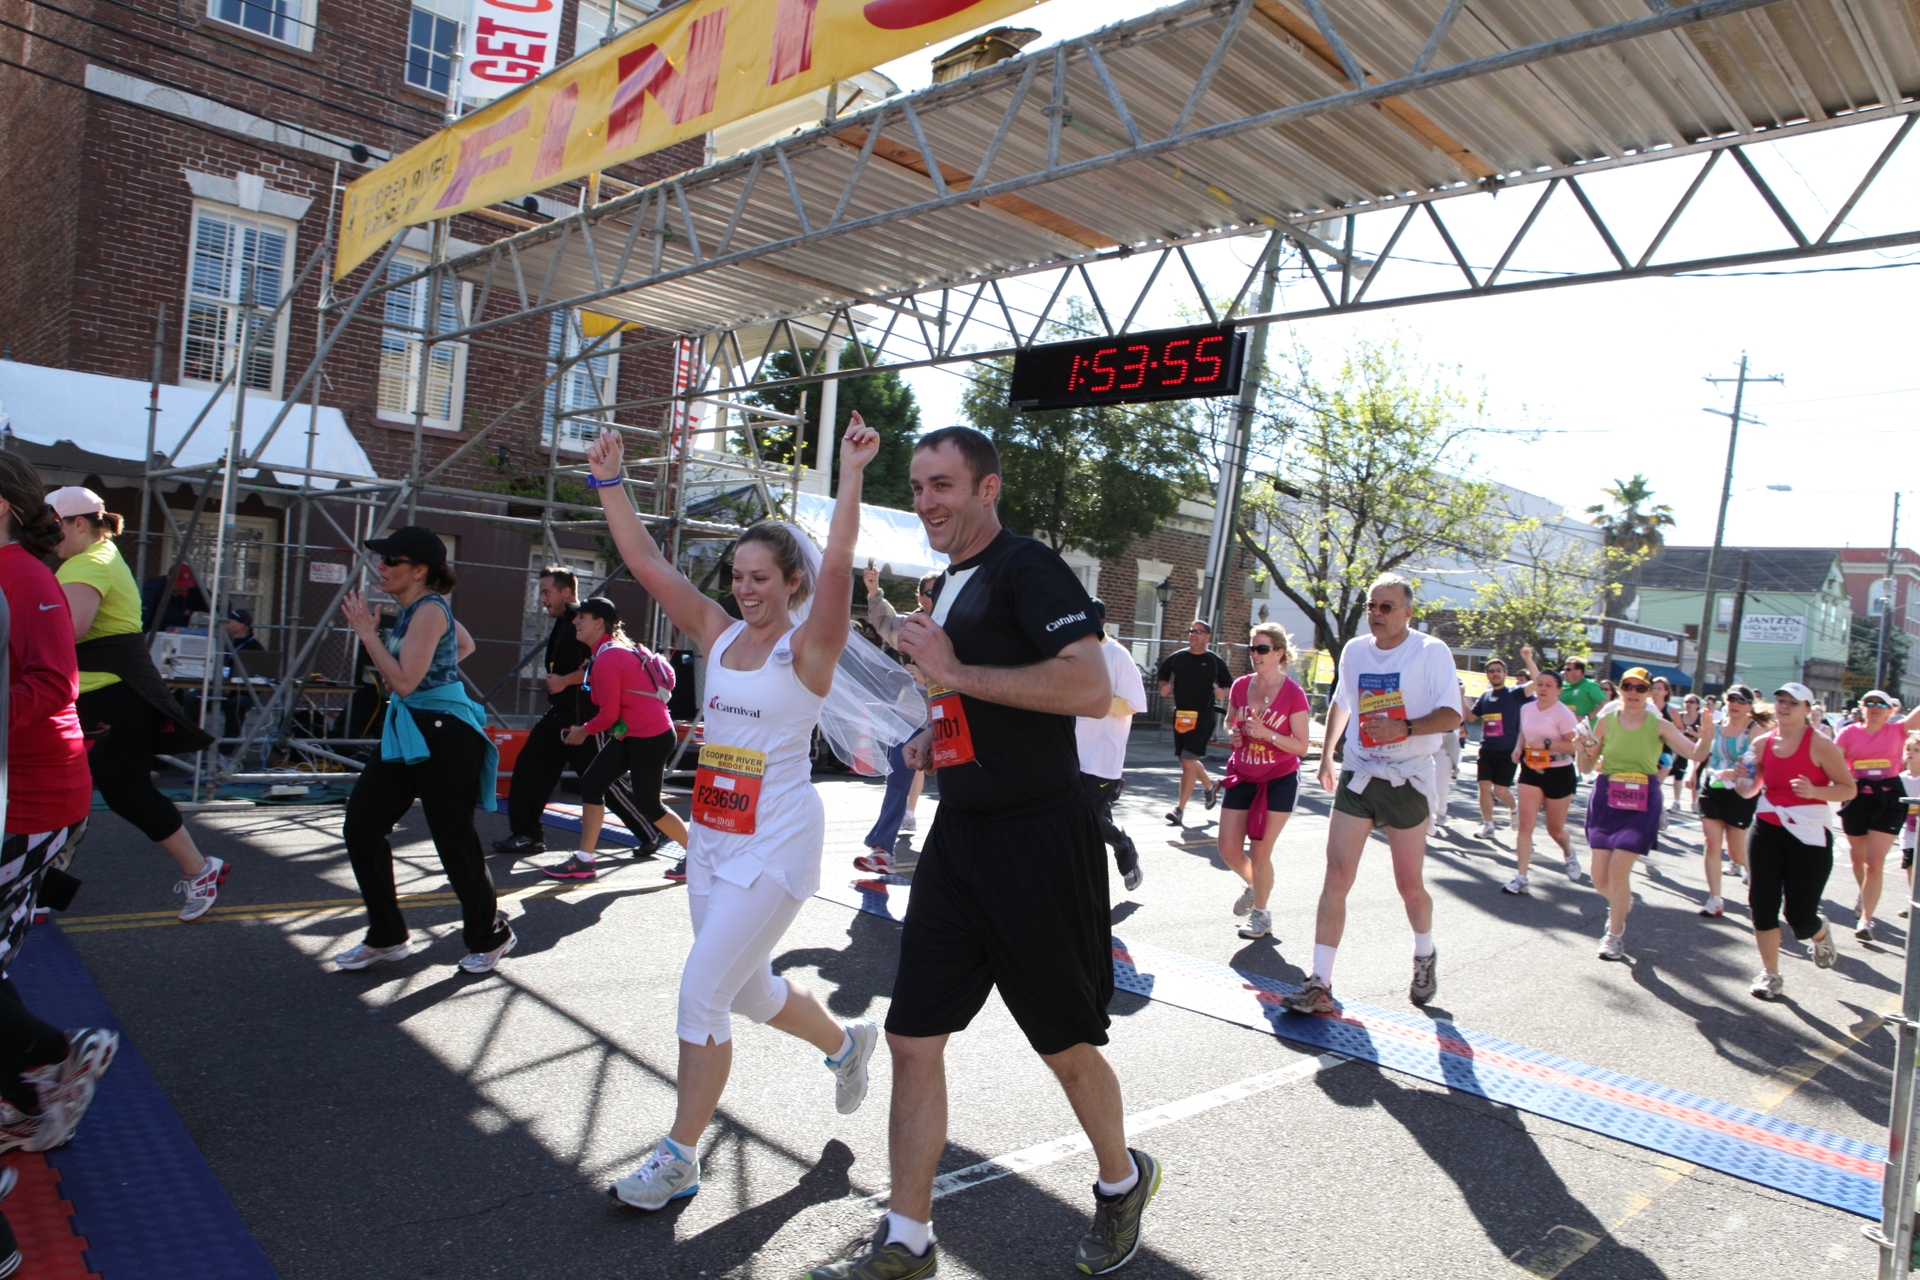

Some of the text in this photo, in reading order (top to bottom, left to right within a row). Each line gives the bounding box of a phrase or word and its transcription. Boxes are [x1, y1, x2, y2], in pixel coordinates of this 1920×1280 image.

[470, 16, 549, 84] GET
[434, 0, 983, 210] FINI
[1045, 611, 1087, 632] Carnival
[1746, 616, 1801, 625] JANTZEN
[716, 702, 761, 719] Carnival
[1363, 699, 1384, 709] COOPER
[705, 750, 763, 767] COOPER RIVER
[1240, 747, 1276, 765] EAGLE
[719, 761, 744, 770] BRIDGE
[745, 764, 762, 774] RUN
[697, 784, 750, 812] F23690
[1612, 789, 1645, 801] G26419
